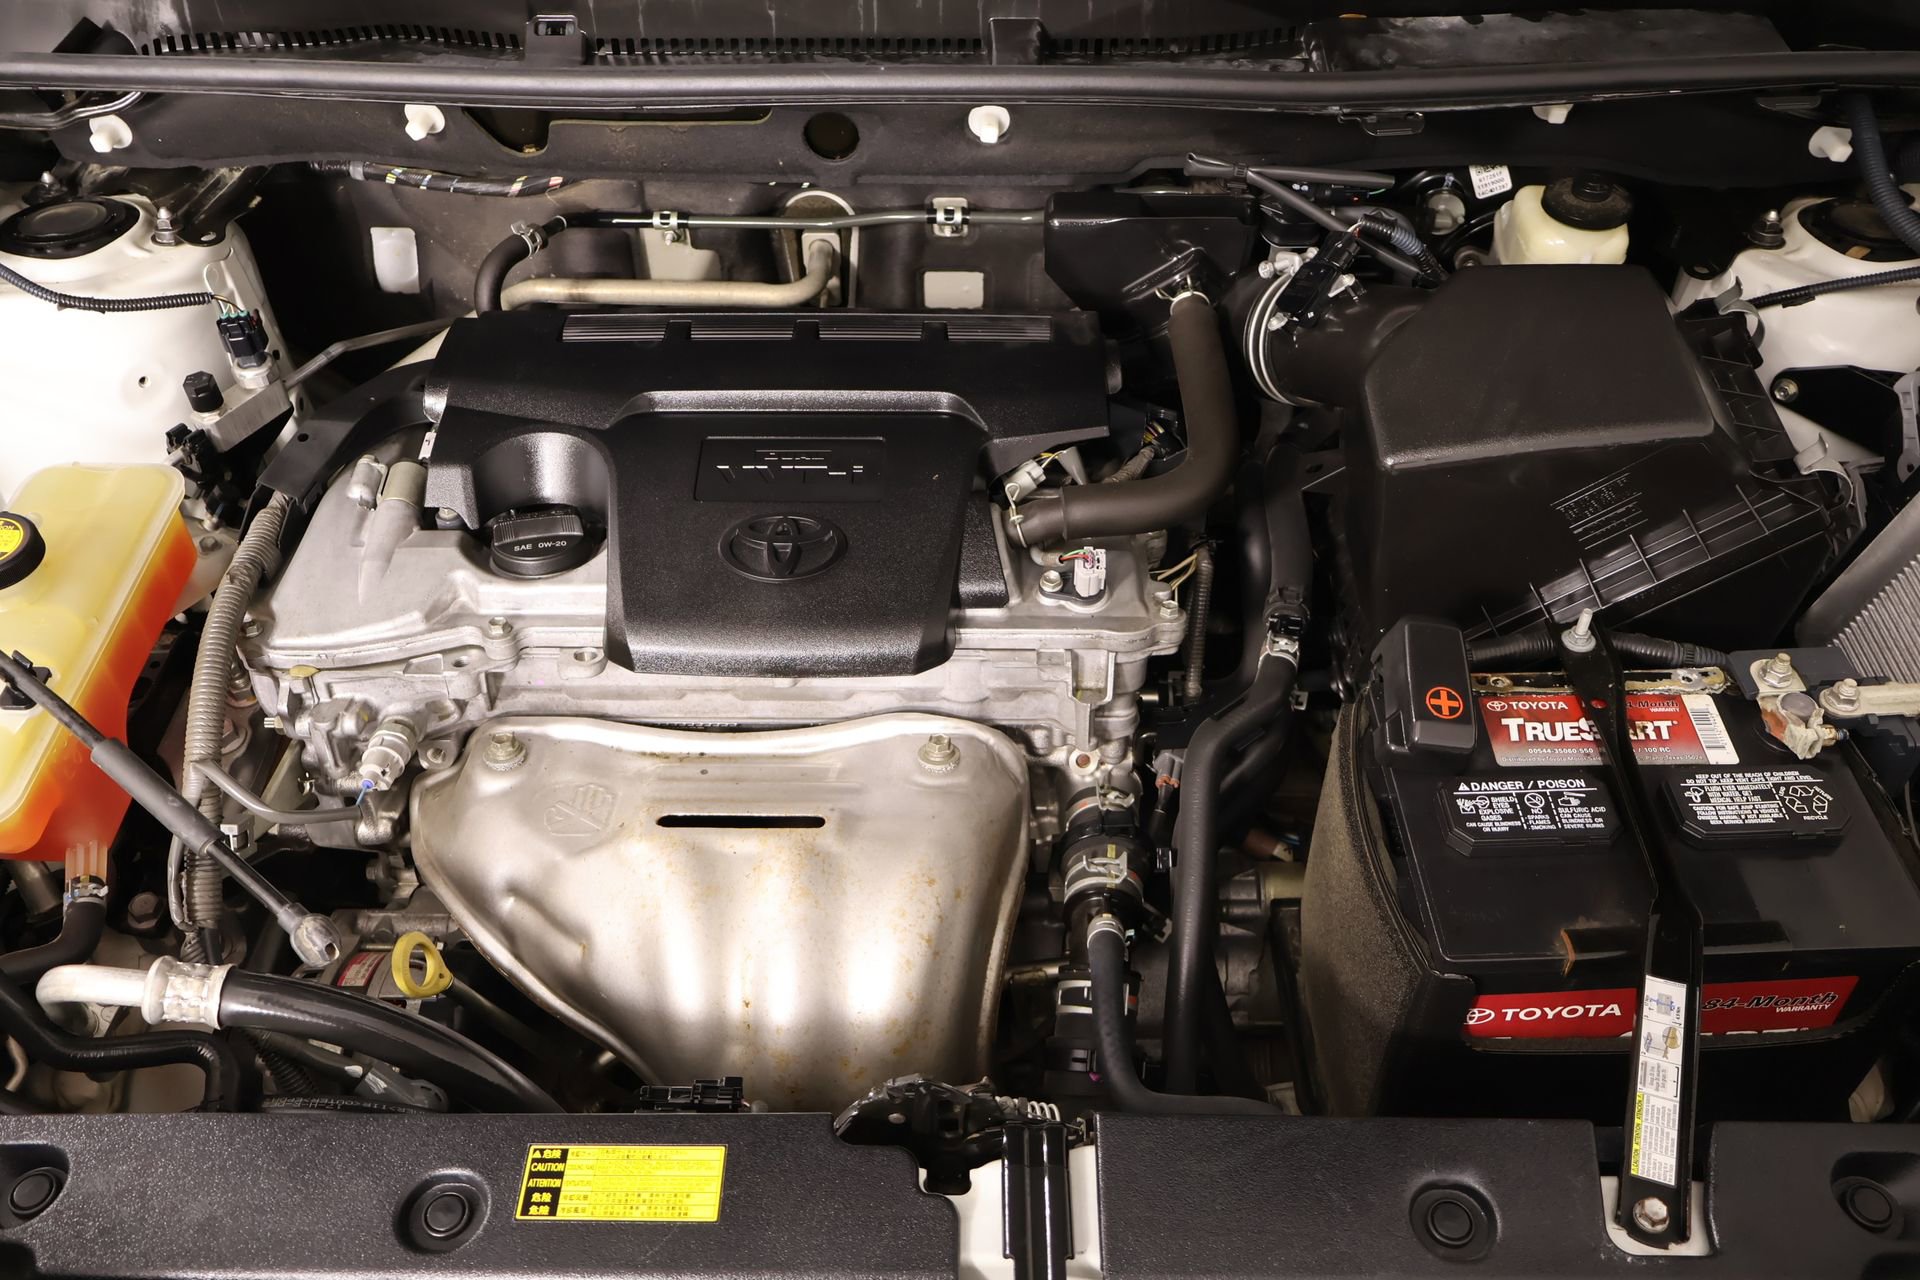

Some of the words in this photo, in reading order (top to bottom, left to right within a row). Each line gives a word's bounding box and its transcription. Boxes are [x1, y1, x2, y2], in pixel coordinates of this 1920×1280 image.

[514, 543, 533, 552] SAE
[538, 540, 567, 549] 0W-20
[1509, 701, 1568, 710] TOYOTA
[1626, 699, 1679, 709] 4-Month
[1470, 780, 1524, 791] DANGER
[1527, 780, 1534, 789] /
[1537, 779, 1586, 789] POISON
[1501, 1003, 1622, 1022] TOYOTA
[1701, 991, 1839, 1011] 84-Month
[1775, 1003, 1832, 1013] WARRANTY
[1632, 1149, 1640, 1167] CAUTION
[531, 1162, 566, 1172] CAUTION
[527, 1178, 562, 1187] ATTENTION
